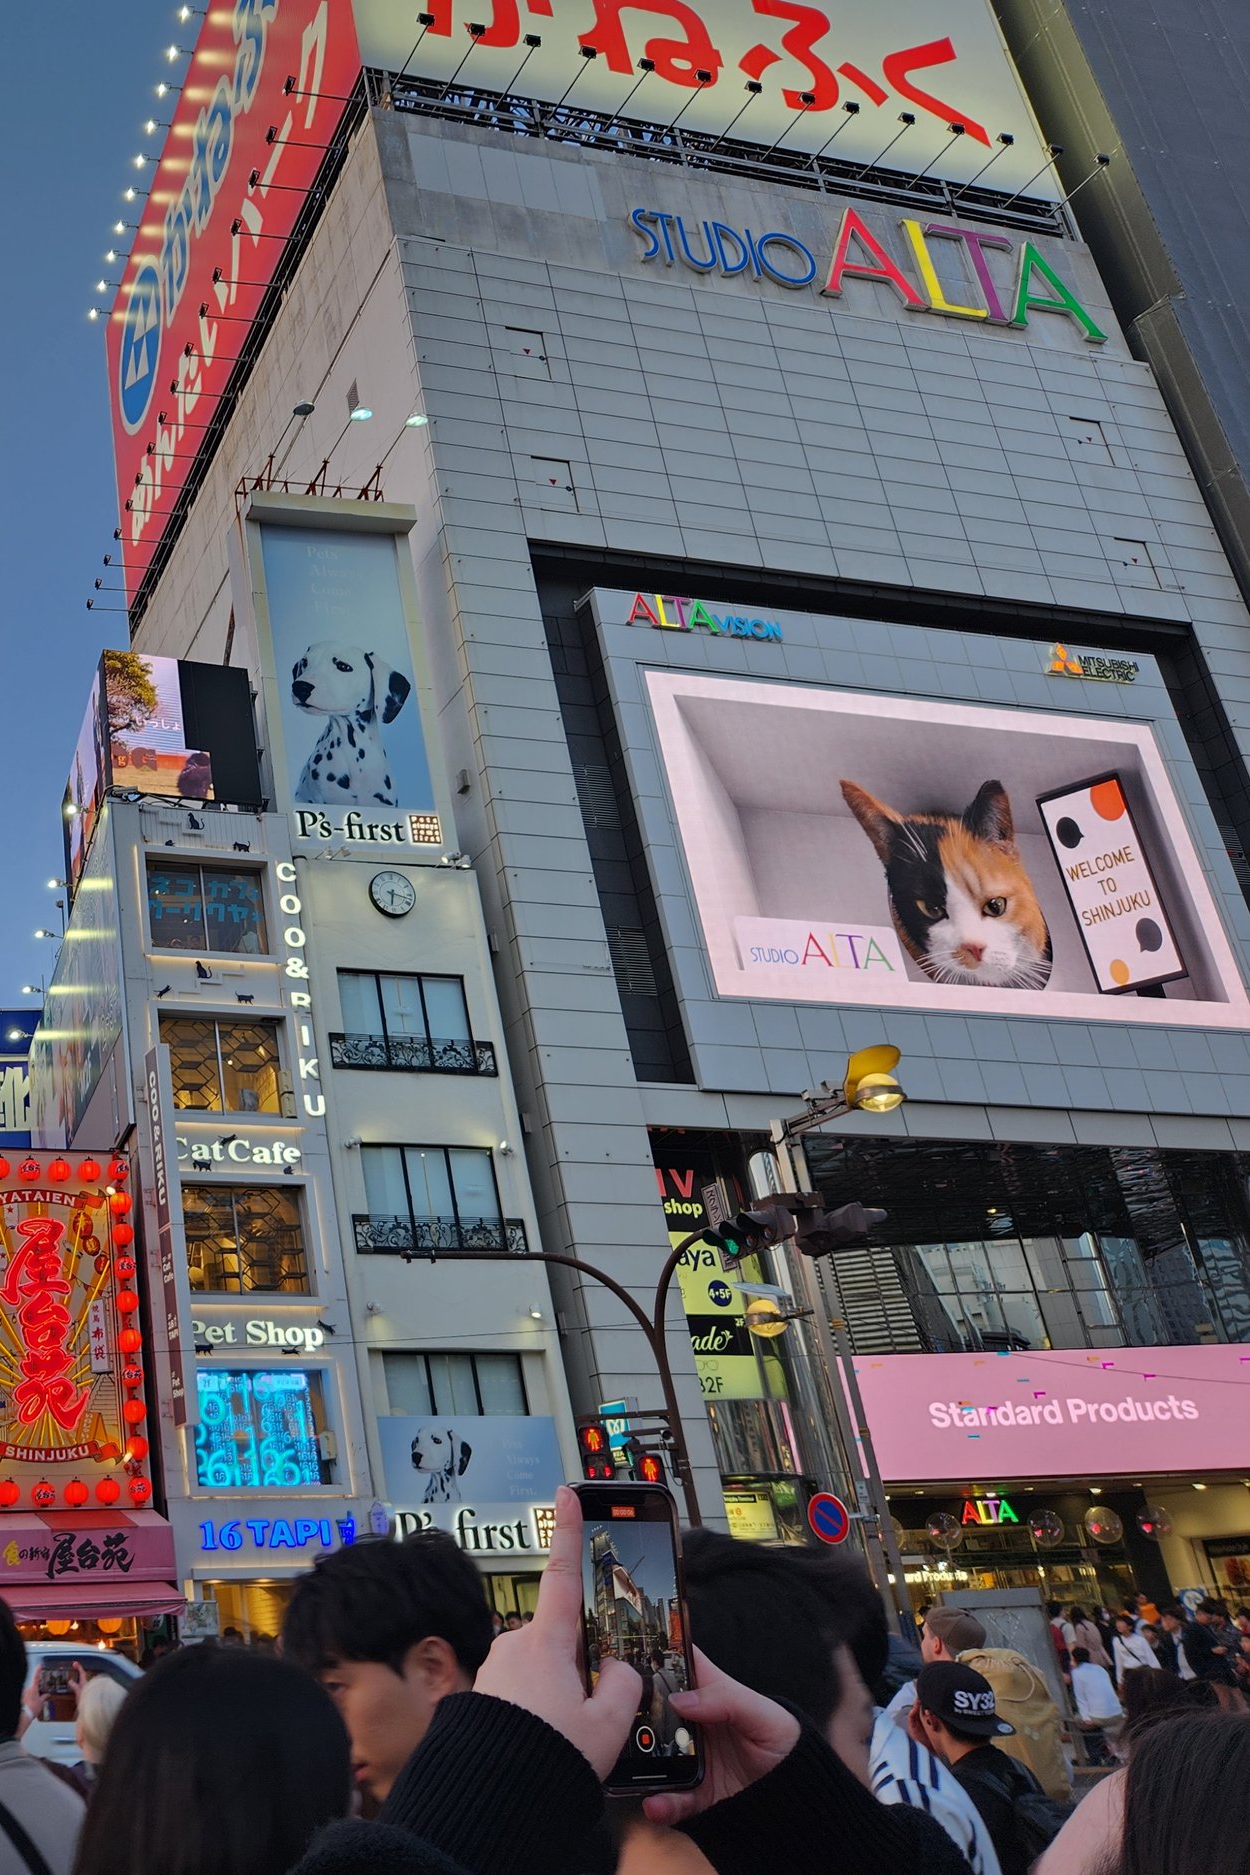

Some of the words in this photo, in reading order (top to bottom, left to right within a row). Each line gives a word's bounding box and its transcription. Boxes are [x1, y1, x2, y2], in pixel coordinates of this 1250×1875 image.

[629, 206, 817, 290] STUDIO
[821, 205, 1108, 345] ALTA
[625, 592, 719, 635] ALTA
[712, 613, 783, 643] VISION
[1078, 655, 1140, 672] MITSUBISHI
[1083, 666, 1135, 682] ELECTRIC
[1065, 845, 1136, 883] WELCOME
[1098, 877, 1118, 897] TO
[1081, 889, 1152, 927] SHINJUKU
[750, 946, 799, 966] STUDIO
[801, 931, 895, 973] ALTA
[228, 1139, 302, 1165] Cafe
[0, 1191, 76, 1207] YATAIEN
[663, 1198, 703, 1219] shop
[245, 1319, 324, 1352] Shop
[929, 1400, 1063, 1428] Standard
[1066, 1395, 1199, 1424] Products
[5, 1444, 90, 1461] SHINJUKU
[962, 1500, 1019, 1525] ALTA
[200, 1519, 244, 1551] 16
[245, 1518, 333, 1549] TAPI
